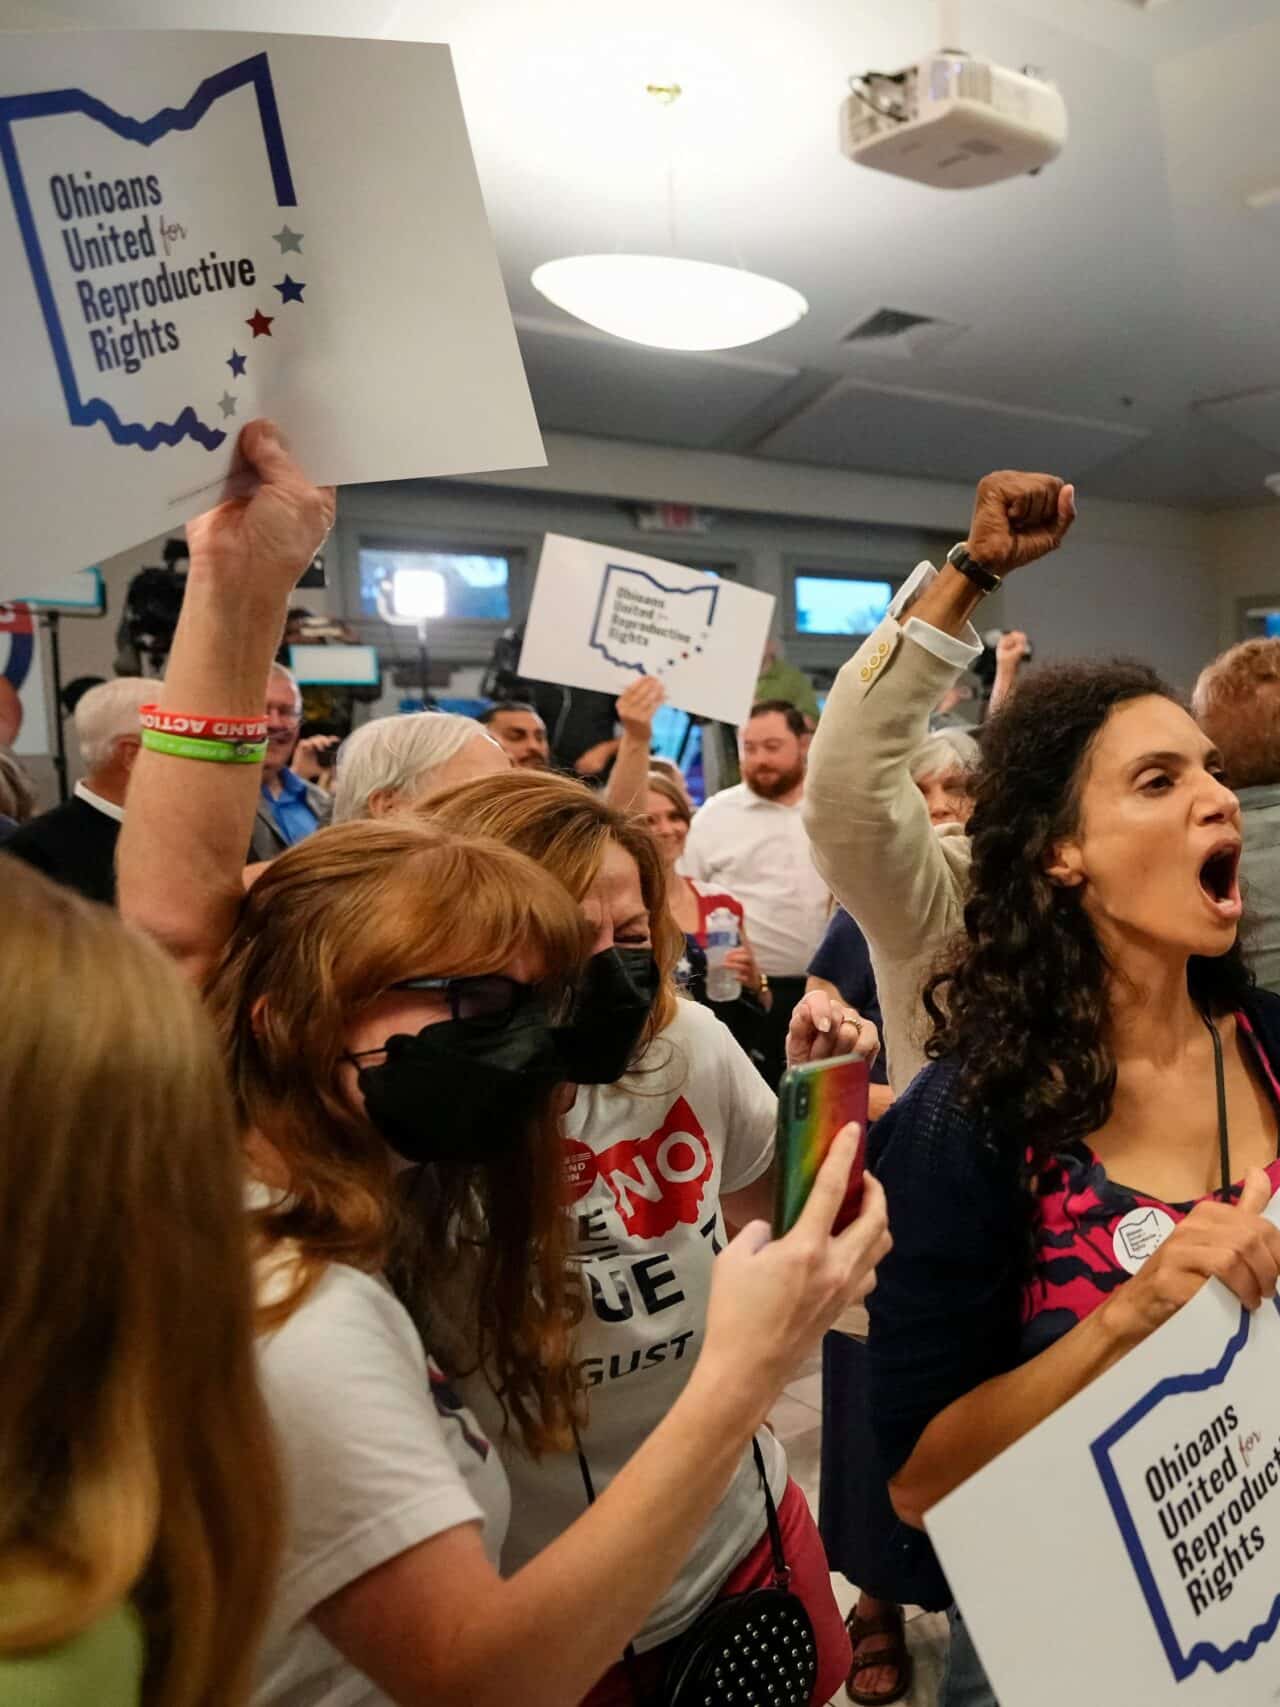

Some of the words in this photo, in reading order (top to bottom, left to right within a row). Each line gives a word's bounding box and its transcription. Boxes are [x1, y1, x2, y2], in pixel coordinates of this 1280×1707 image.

[50, 171, 162, 221] Ohioans
[62, 216, 156, 272] United
[160, 215, 187, 256] for
[76, 252, 256, 325] Reproductive
[89, 319, 180, 374] Rights
[609, 1130, 707, 1219] NO
[579, 1329, 694, 1387] GUST
[1144, 1404, 1239, 1504] Ohioans
[1157, 1446, 1238, 1541] United
[1238, 1430, 1262, 1468] for
[1186, 1524, 1266, 1618] Rights
